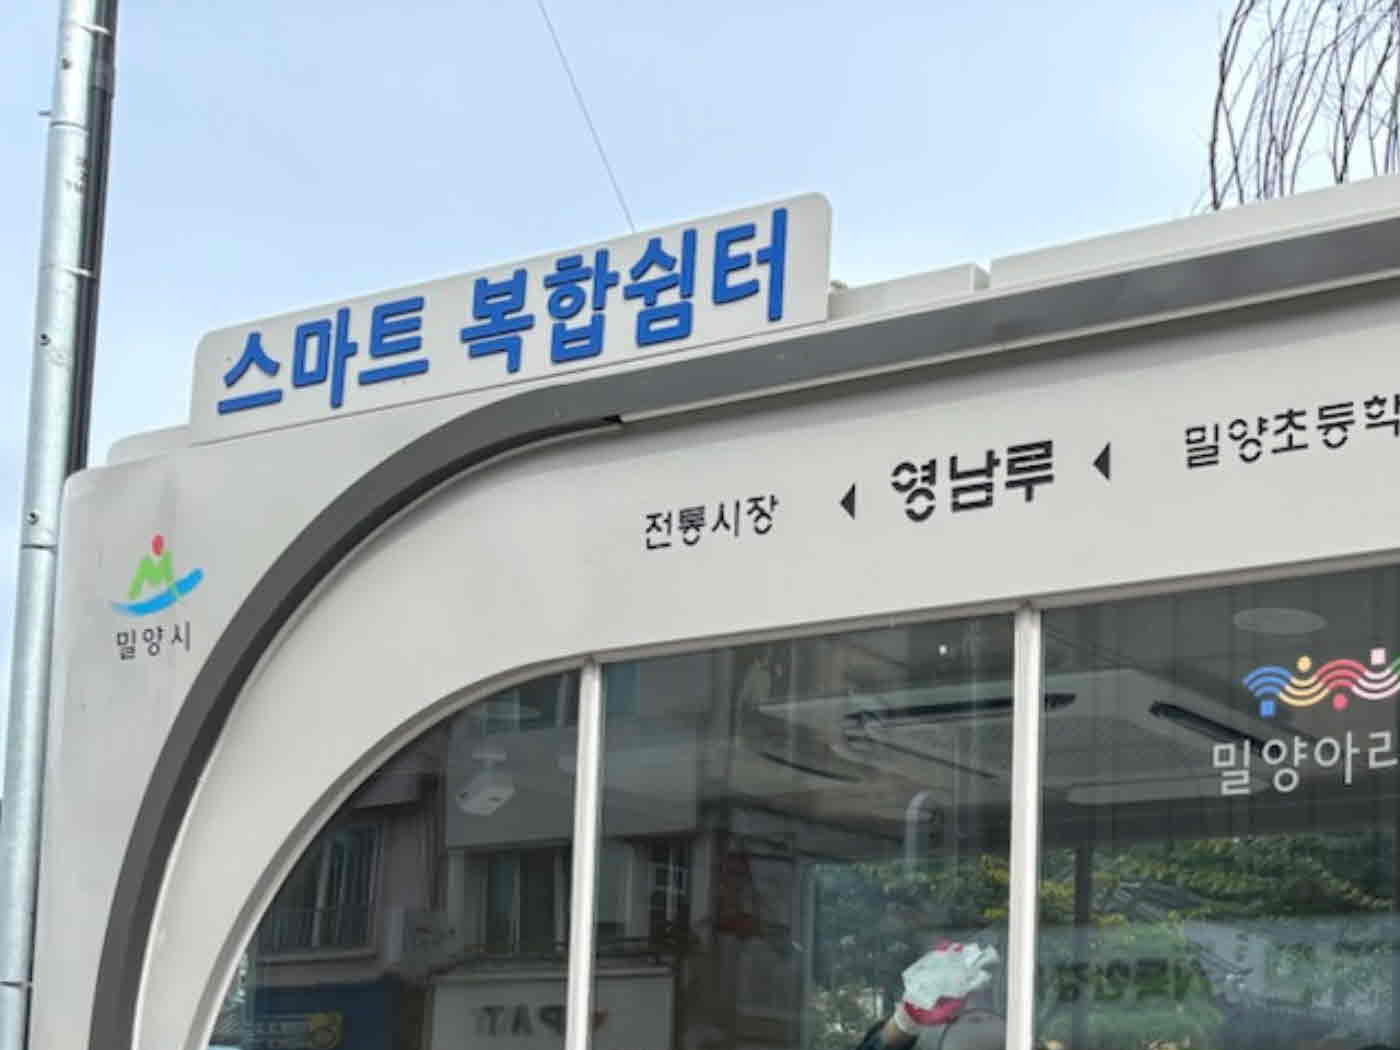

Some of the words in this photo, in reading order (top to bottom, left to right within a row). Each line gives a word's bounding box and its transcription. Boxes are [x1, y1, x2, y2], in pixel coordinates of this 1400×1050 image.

[217, 296, 429, 415] 스마트
[459, 208, 787, 374] 복합쉼터
[891, 440, 1055, 522] 영남루
[645, 494, 778, 550] 전통시장
[116, 620, 190, 661] 밀양시
